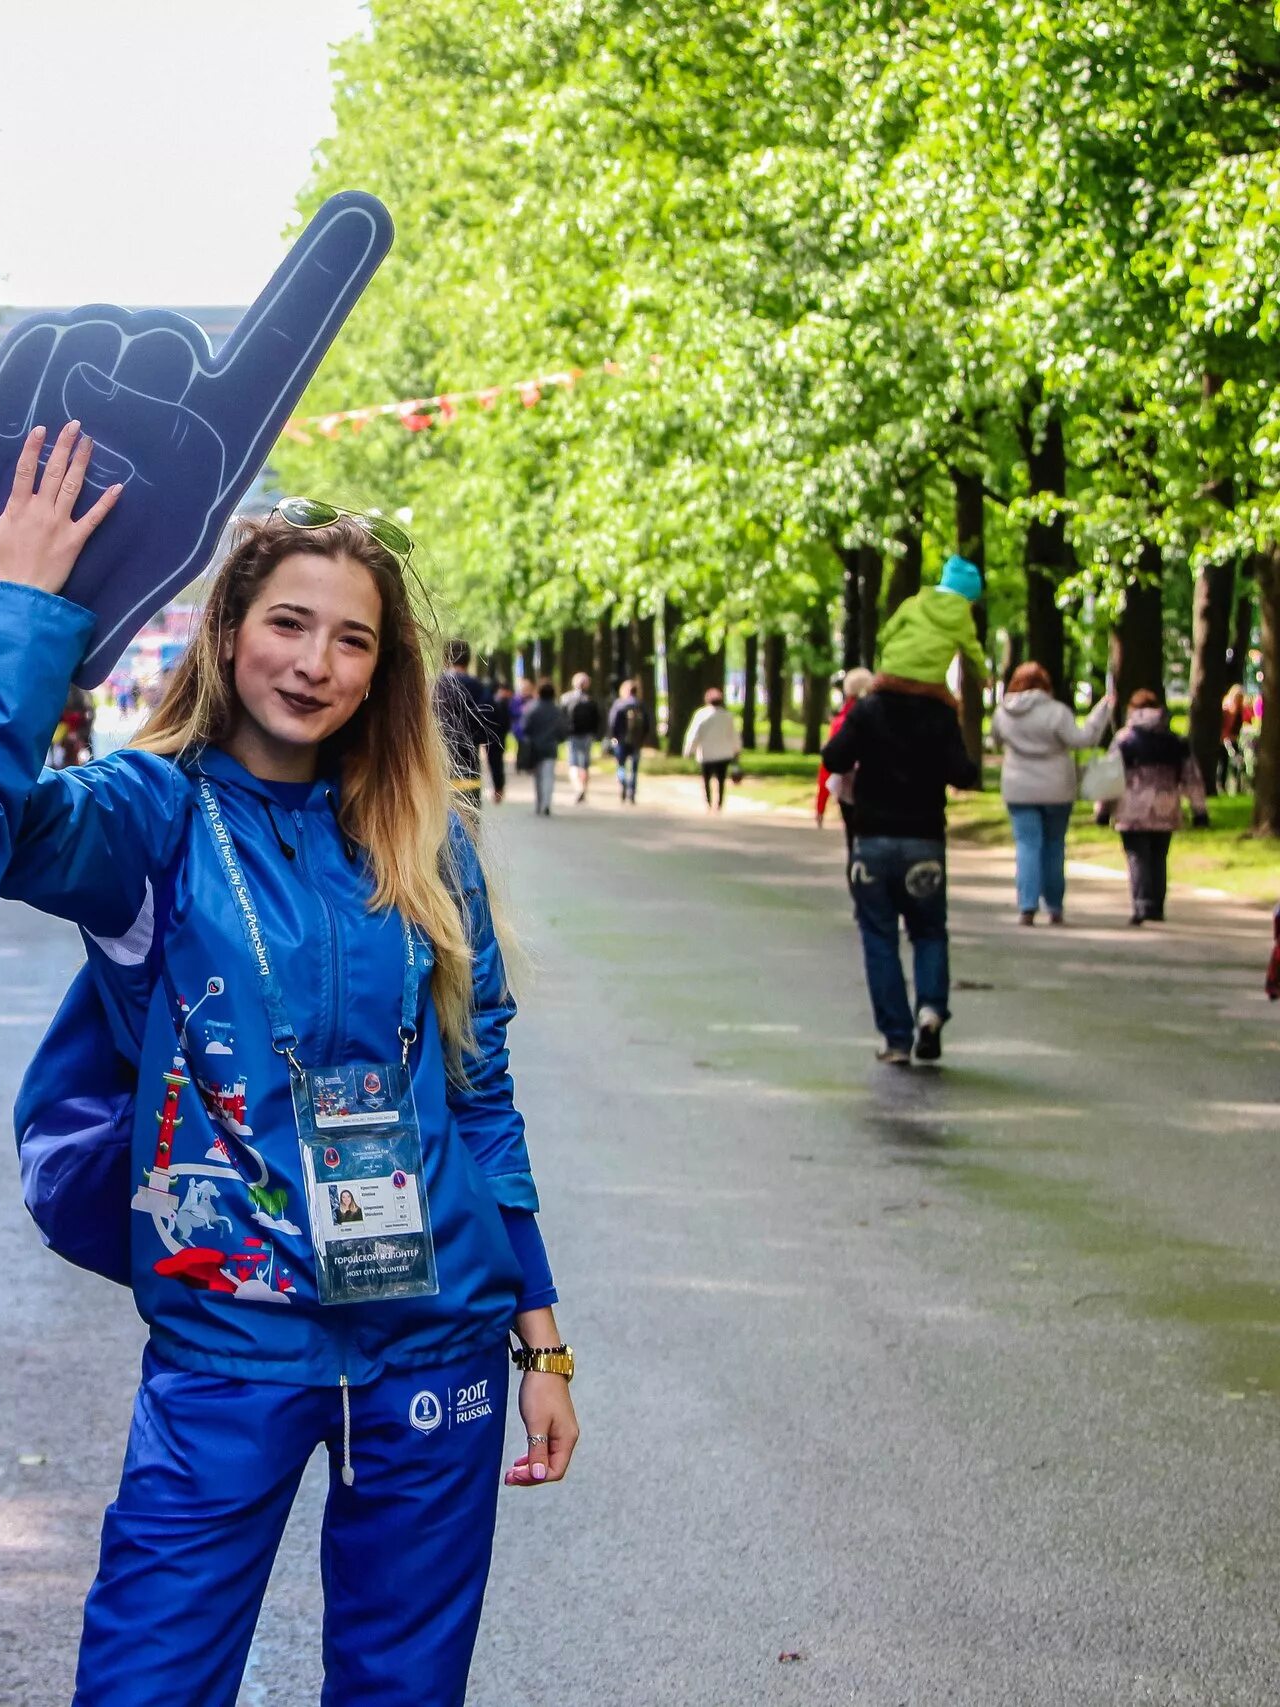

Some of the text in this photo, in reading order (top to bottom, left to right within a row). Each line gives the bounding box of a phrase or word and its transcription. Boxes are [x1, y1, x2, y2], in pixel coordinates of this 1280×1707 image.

[200, 783, 211, 799] Cup
[205, 798, 220, 821] FIFA
[212, 821, 230, 845] 2017
[221, 845, 236, 869] host
[228, 867, 242, 885] city
[235, 886, 271, 977] Saint-Petersburg
[334, 1249, 419, 1265] ГОРОДСКОЙ ВОЛОНТЕР
[363, 1268, 376, 1276] CITY
[377, 1265, 410, 1275] VOLUNTEER
[456, 1379, 488, 1407] 2017
[456, 1403, 493, 1424] RUSSIA
